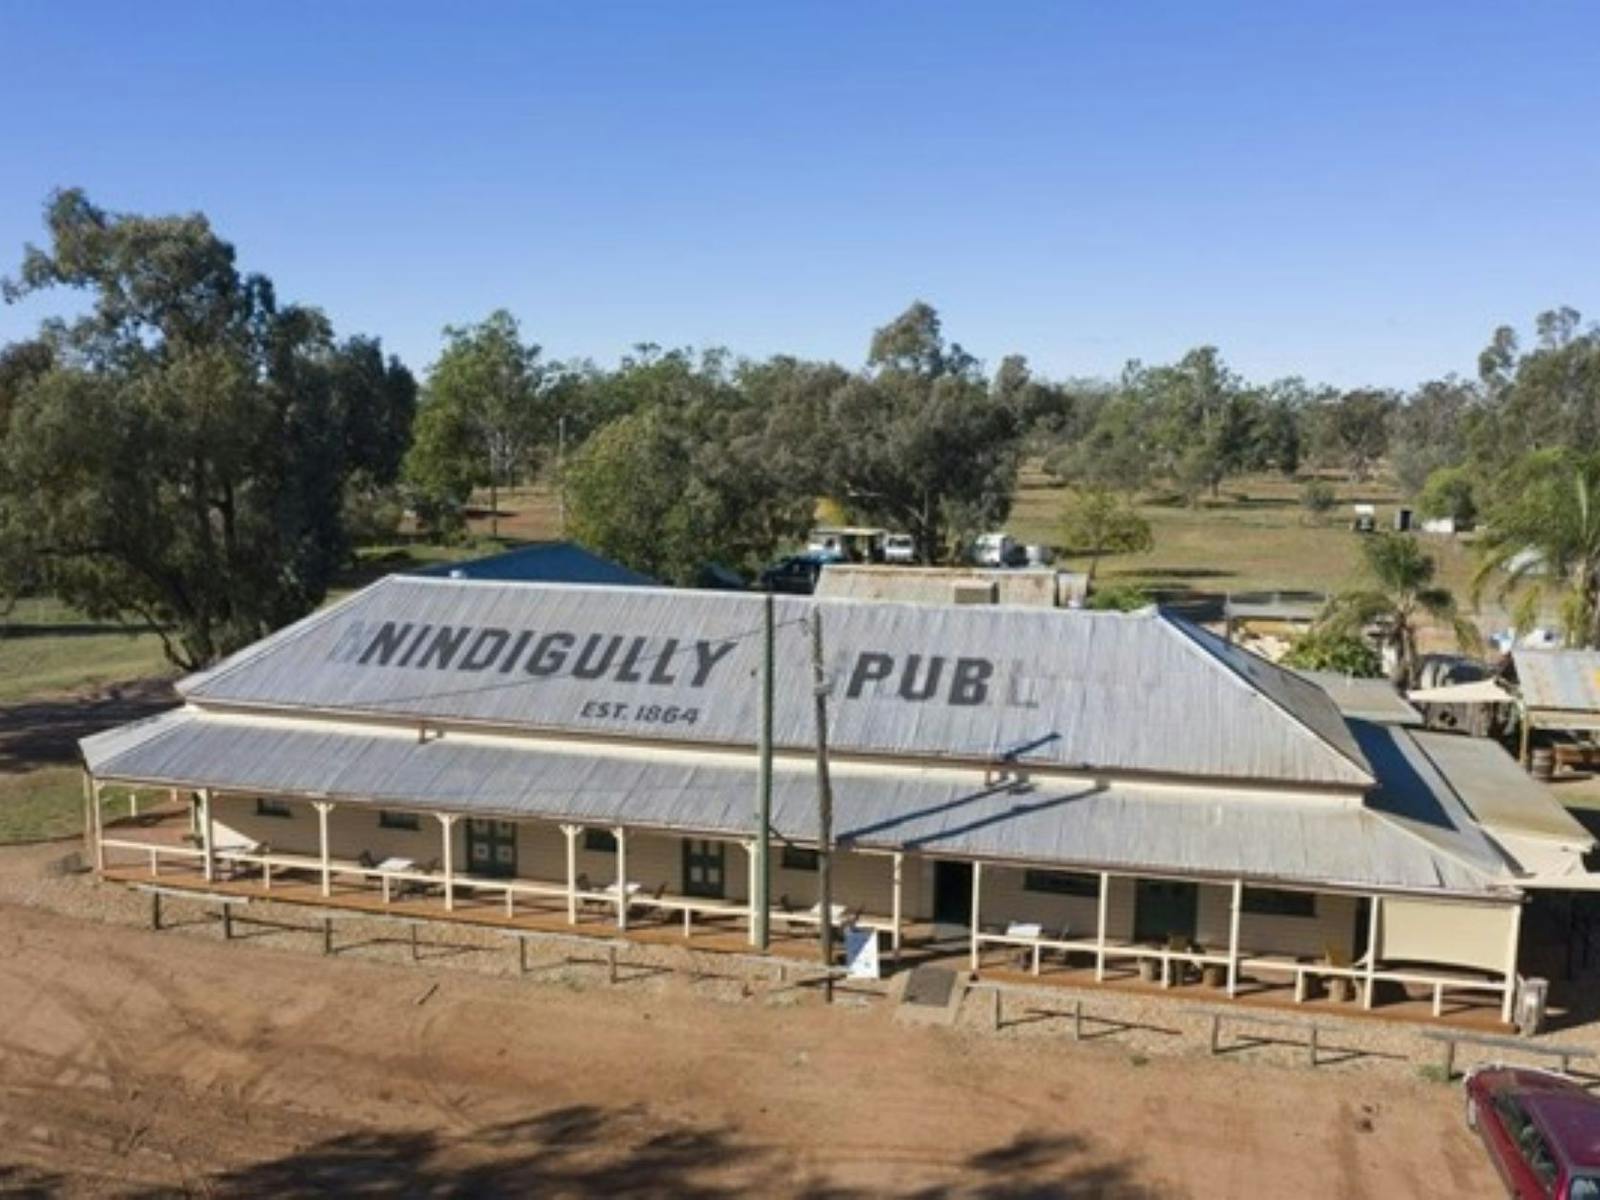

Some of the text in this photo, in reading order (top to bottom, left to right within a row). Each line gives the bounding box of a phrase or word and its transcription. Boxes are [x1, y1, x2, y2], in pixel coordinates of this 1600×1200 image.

[358, 620, 994, 706] NINDIGULLY PUB
[580, 701, 700, 725] EST. 1864
